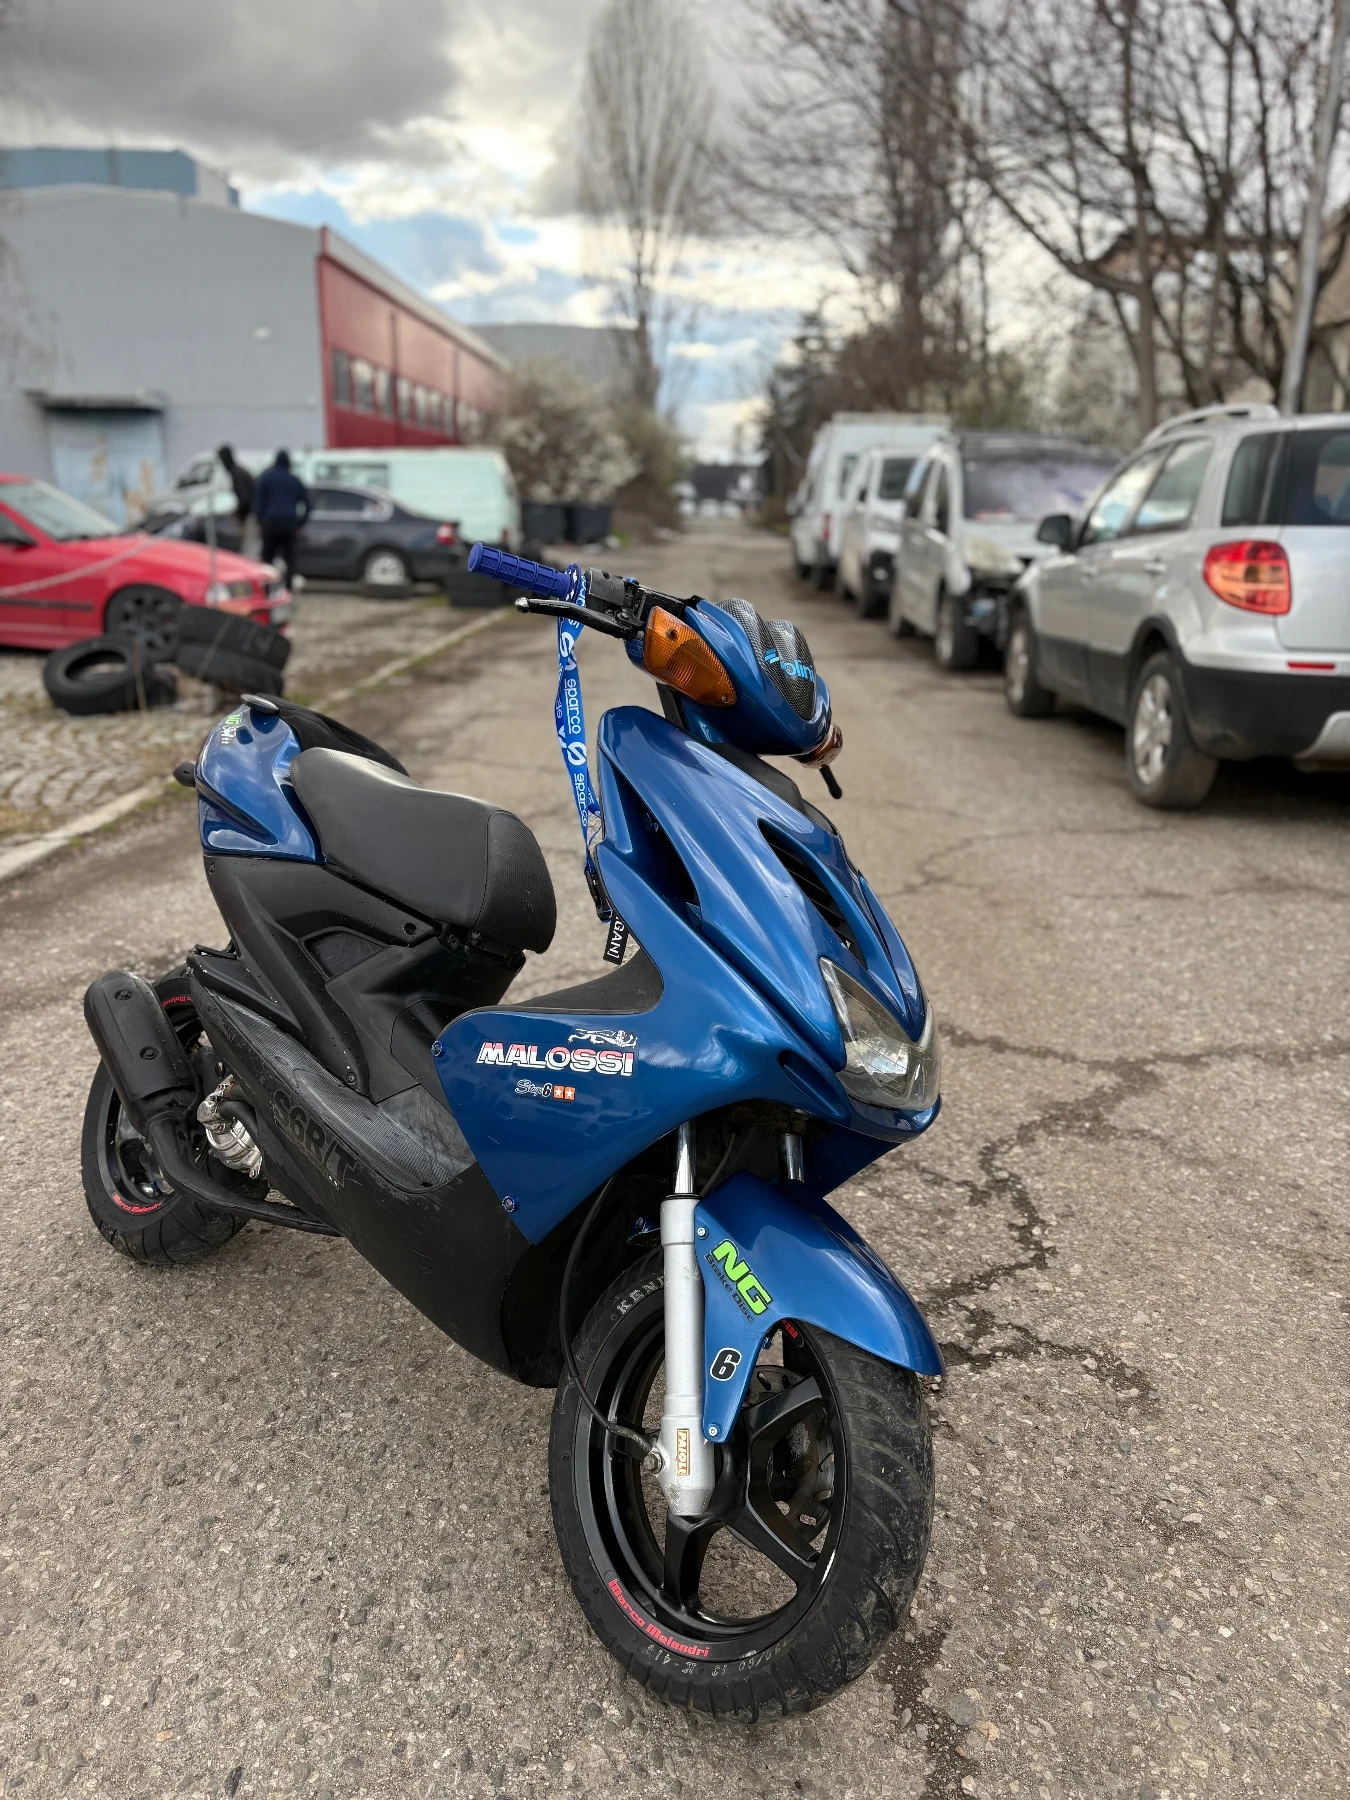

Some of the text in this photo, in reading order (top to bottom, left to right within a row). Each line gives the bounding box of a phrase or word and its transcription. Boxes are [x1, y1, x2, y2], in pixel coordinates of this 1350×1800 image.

[564, 678, 582, 735] sparco
[476, 1041, 635, 1077] MALOSSI
[704, 1253, 733, 1293] Brake
[710, 1239, 775, 1316] NG
[709, 1347, 742, 1381] 6
[608, 1578, 711, 1658] Marco Melandri
